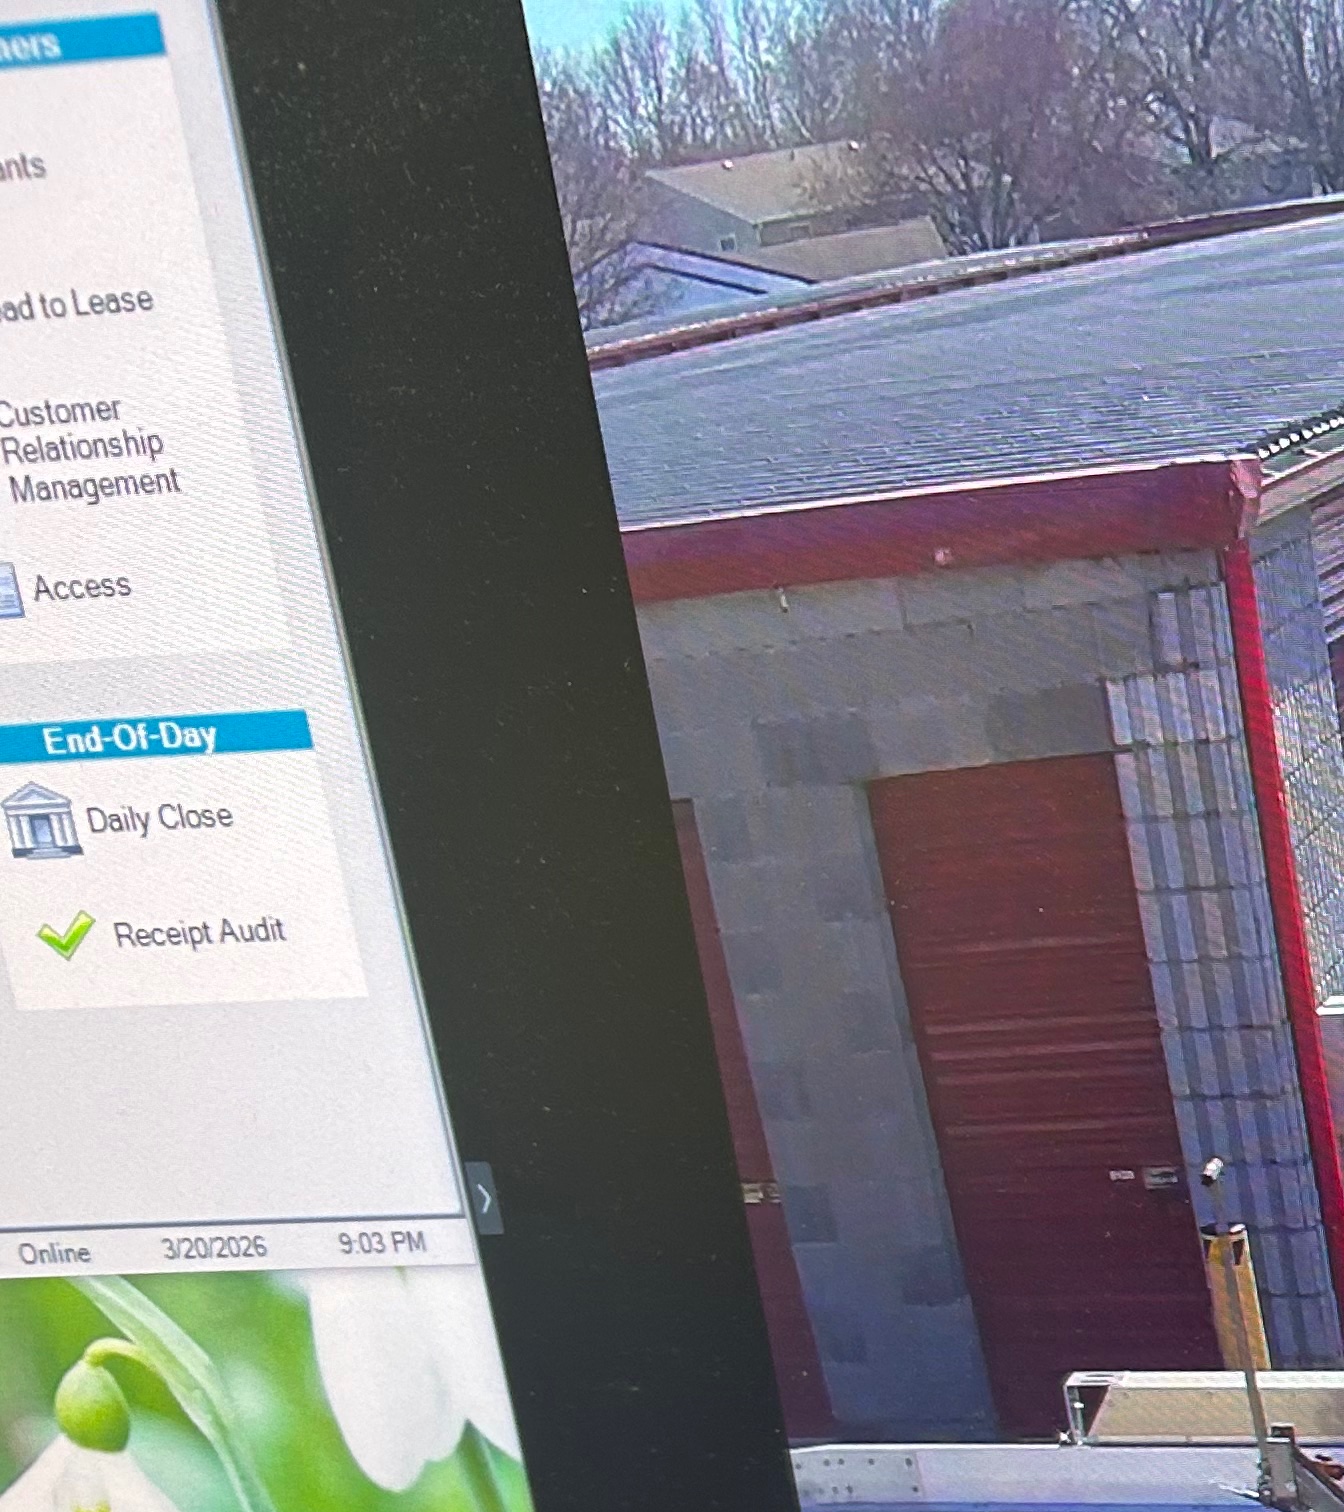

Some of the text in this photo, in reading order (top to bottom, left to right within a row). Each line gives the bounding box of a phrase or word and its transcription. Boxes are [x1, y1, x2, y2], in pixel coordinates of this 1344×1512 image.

[0, 287, 154, 322] ad to Lease
[0, 399, 121, 428] Customer
[0, 426, 164, 465] Relationship
[9, 467, 183, 506] Management
[33, 572, 132, 603] Access
[43, 722, 218, 756] End-Of-Day
[87, 802, 234, 839] Daily Close
[114, 915, 287, 951] Receipt Audit
[18, 1242, 91, 1267] Online
[163, 1234, 268, 1261] 3/20/2026
[338, 1230, 427, 1256] 9:03 PM
